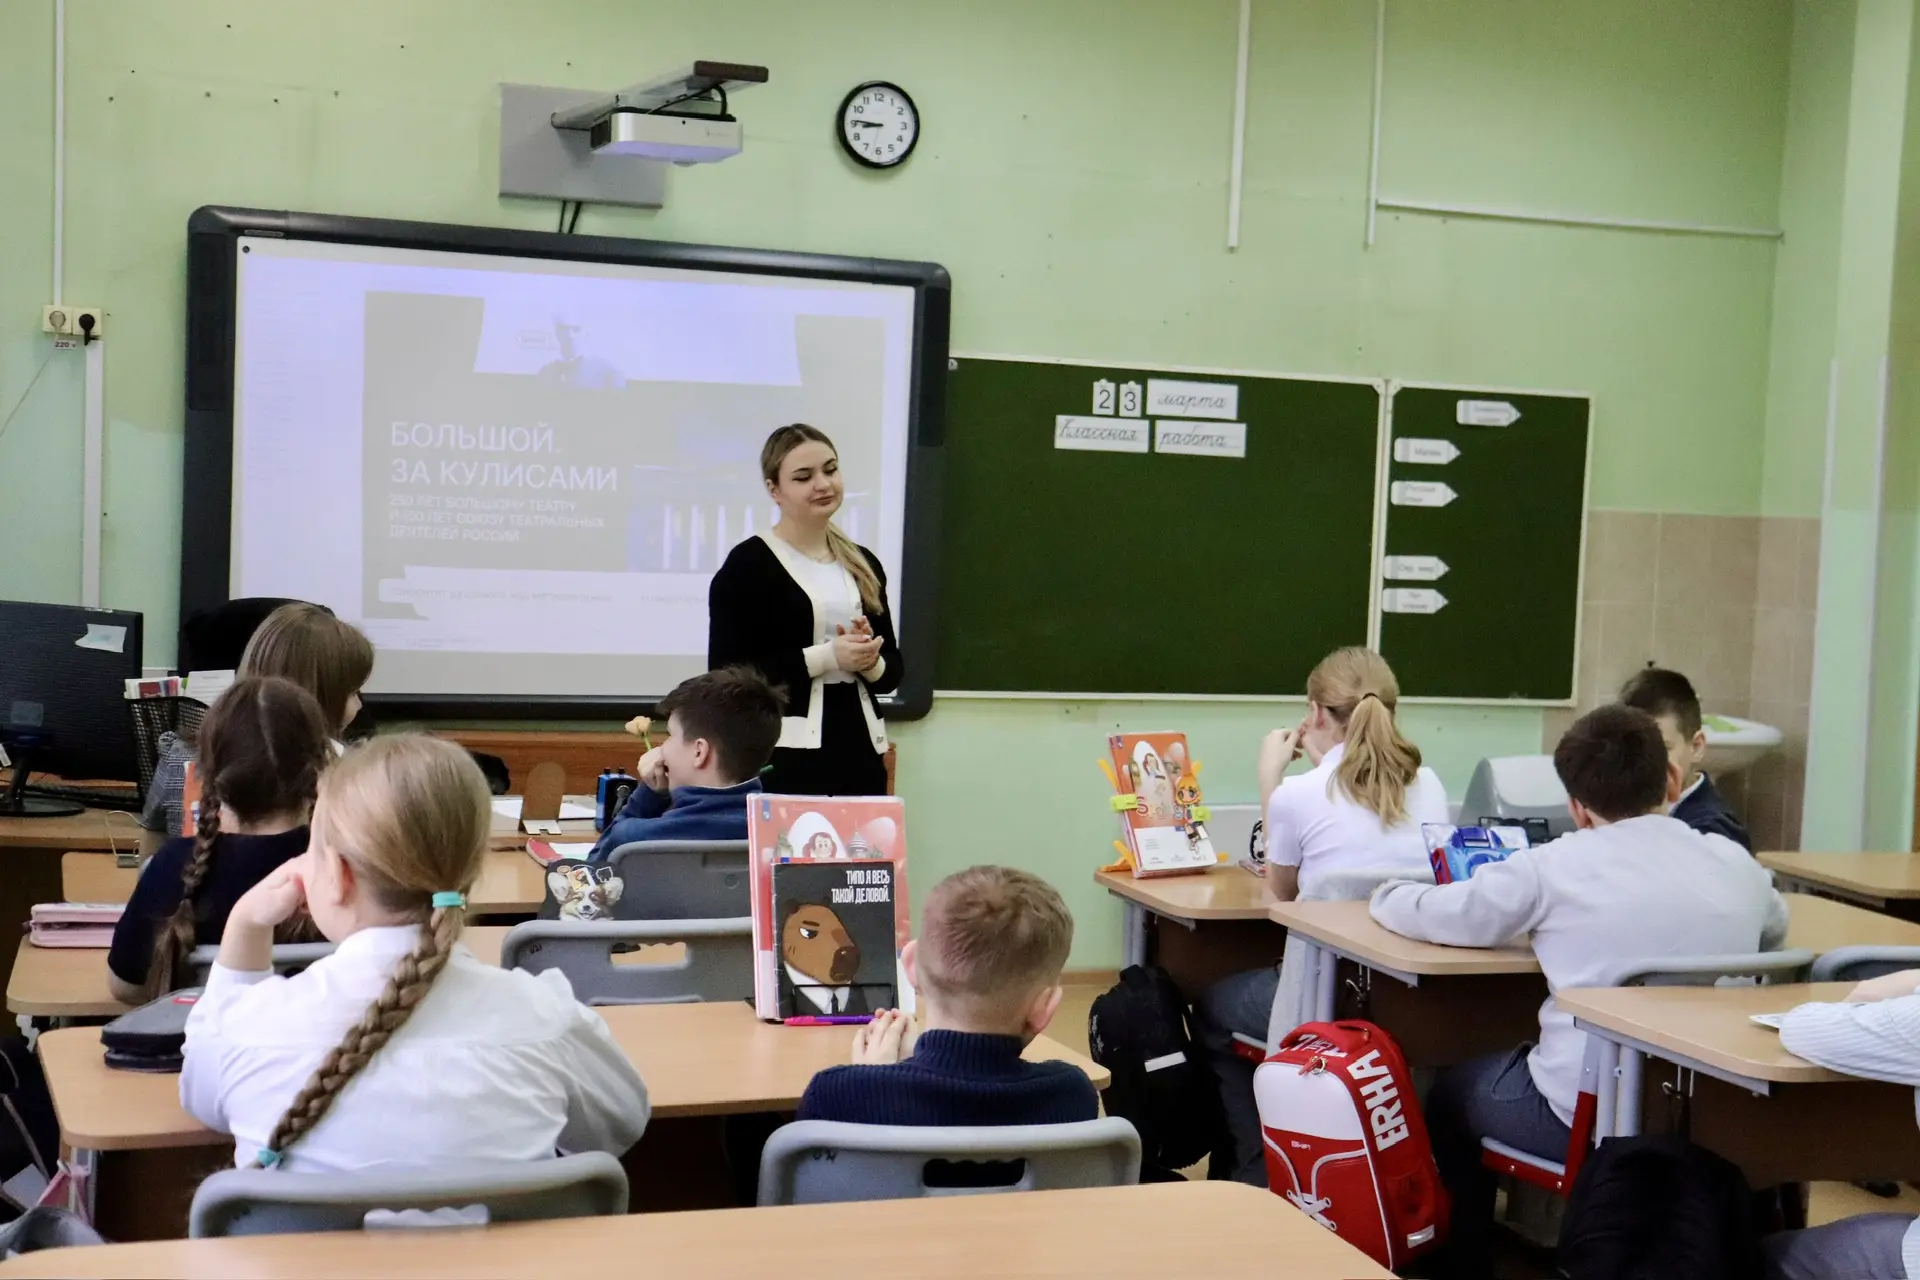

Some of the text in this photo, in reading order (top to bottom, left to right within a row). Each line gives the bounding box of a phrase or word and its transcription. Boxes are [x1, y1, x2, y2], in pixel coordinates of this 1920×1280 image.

[862, 97, 870, 105] 11
[874, 93, 884, 102] 12
[853, 105, 864, 114] 10
[1157, 393, 1227, 414] марта
[391, 420, 563, 453] БОЛЬШОЙ.
[1059, 417, 1228, 449] Классная работа
[391, 457, 618, 491] ЗА КУЛИСАМИ
[417, 495, 443, 508] ЛЕТ
[529, 500, 578, 514] ТЕАТРУ
[456, 513, 505, 526] СОЮЗУ
[509, 514, 606, 529] ТЕАТРАЛЬНЫХ
[845, 869, 890, 885] ТИПО Я ВЕСЬ
[831, 884, 891, 905] ТАКОЙ ДЕЛОВОЙ.
[1346, 1048, 1410, 1152] ERHA
